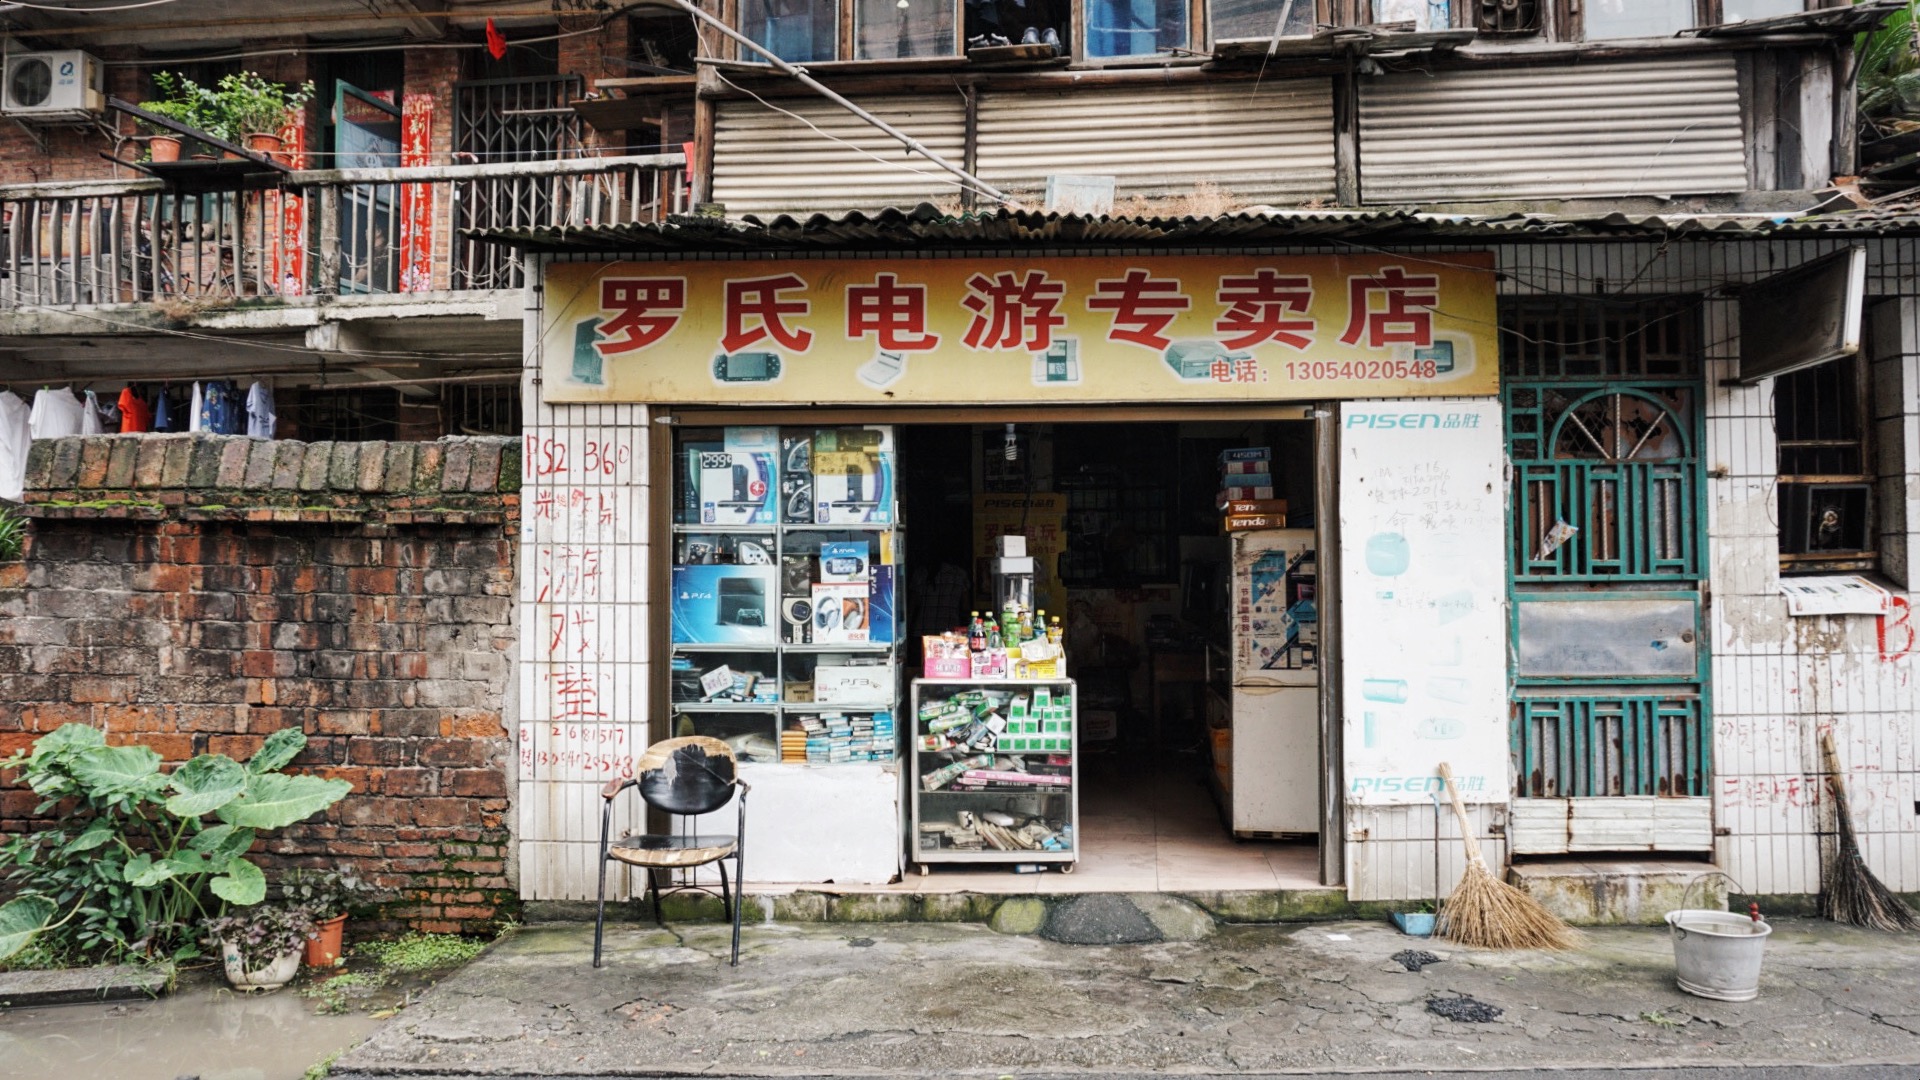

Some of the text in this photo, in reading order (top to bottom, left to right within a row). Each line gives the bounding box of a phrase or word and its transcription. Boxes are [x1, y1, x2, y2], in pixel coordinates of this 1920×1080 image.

[595, 270, 1438, 354] 罗氏电游专卖店
[1286, 360, 1437, 381] 13054020548
[1346, 413, 1482, 429] PISEN 品胜
[584, 441, 630, 475] 360
[1231, 517, 1266, 527] Tenda
